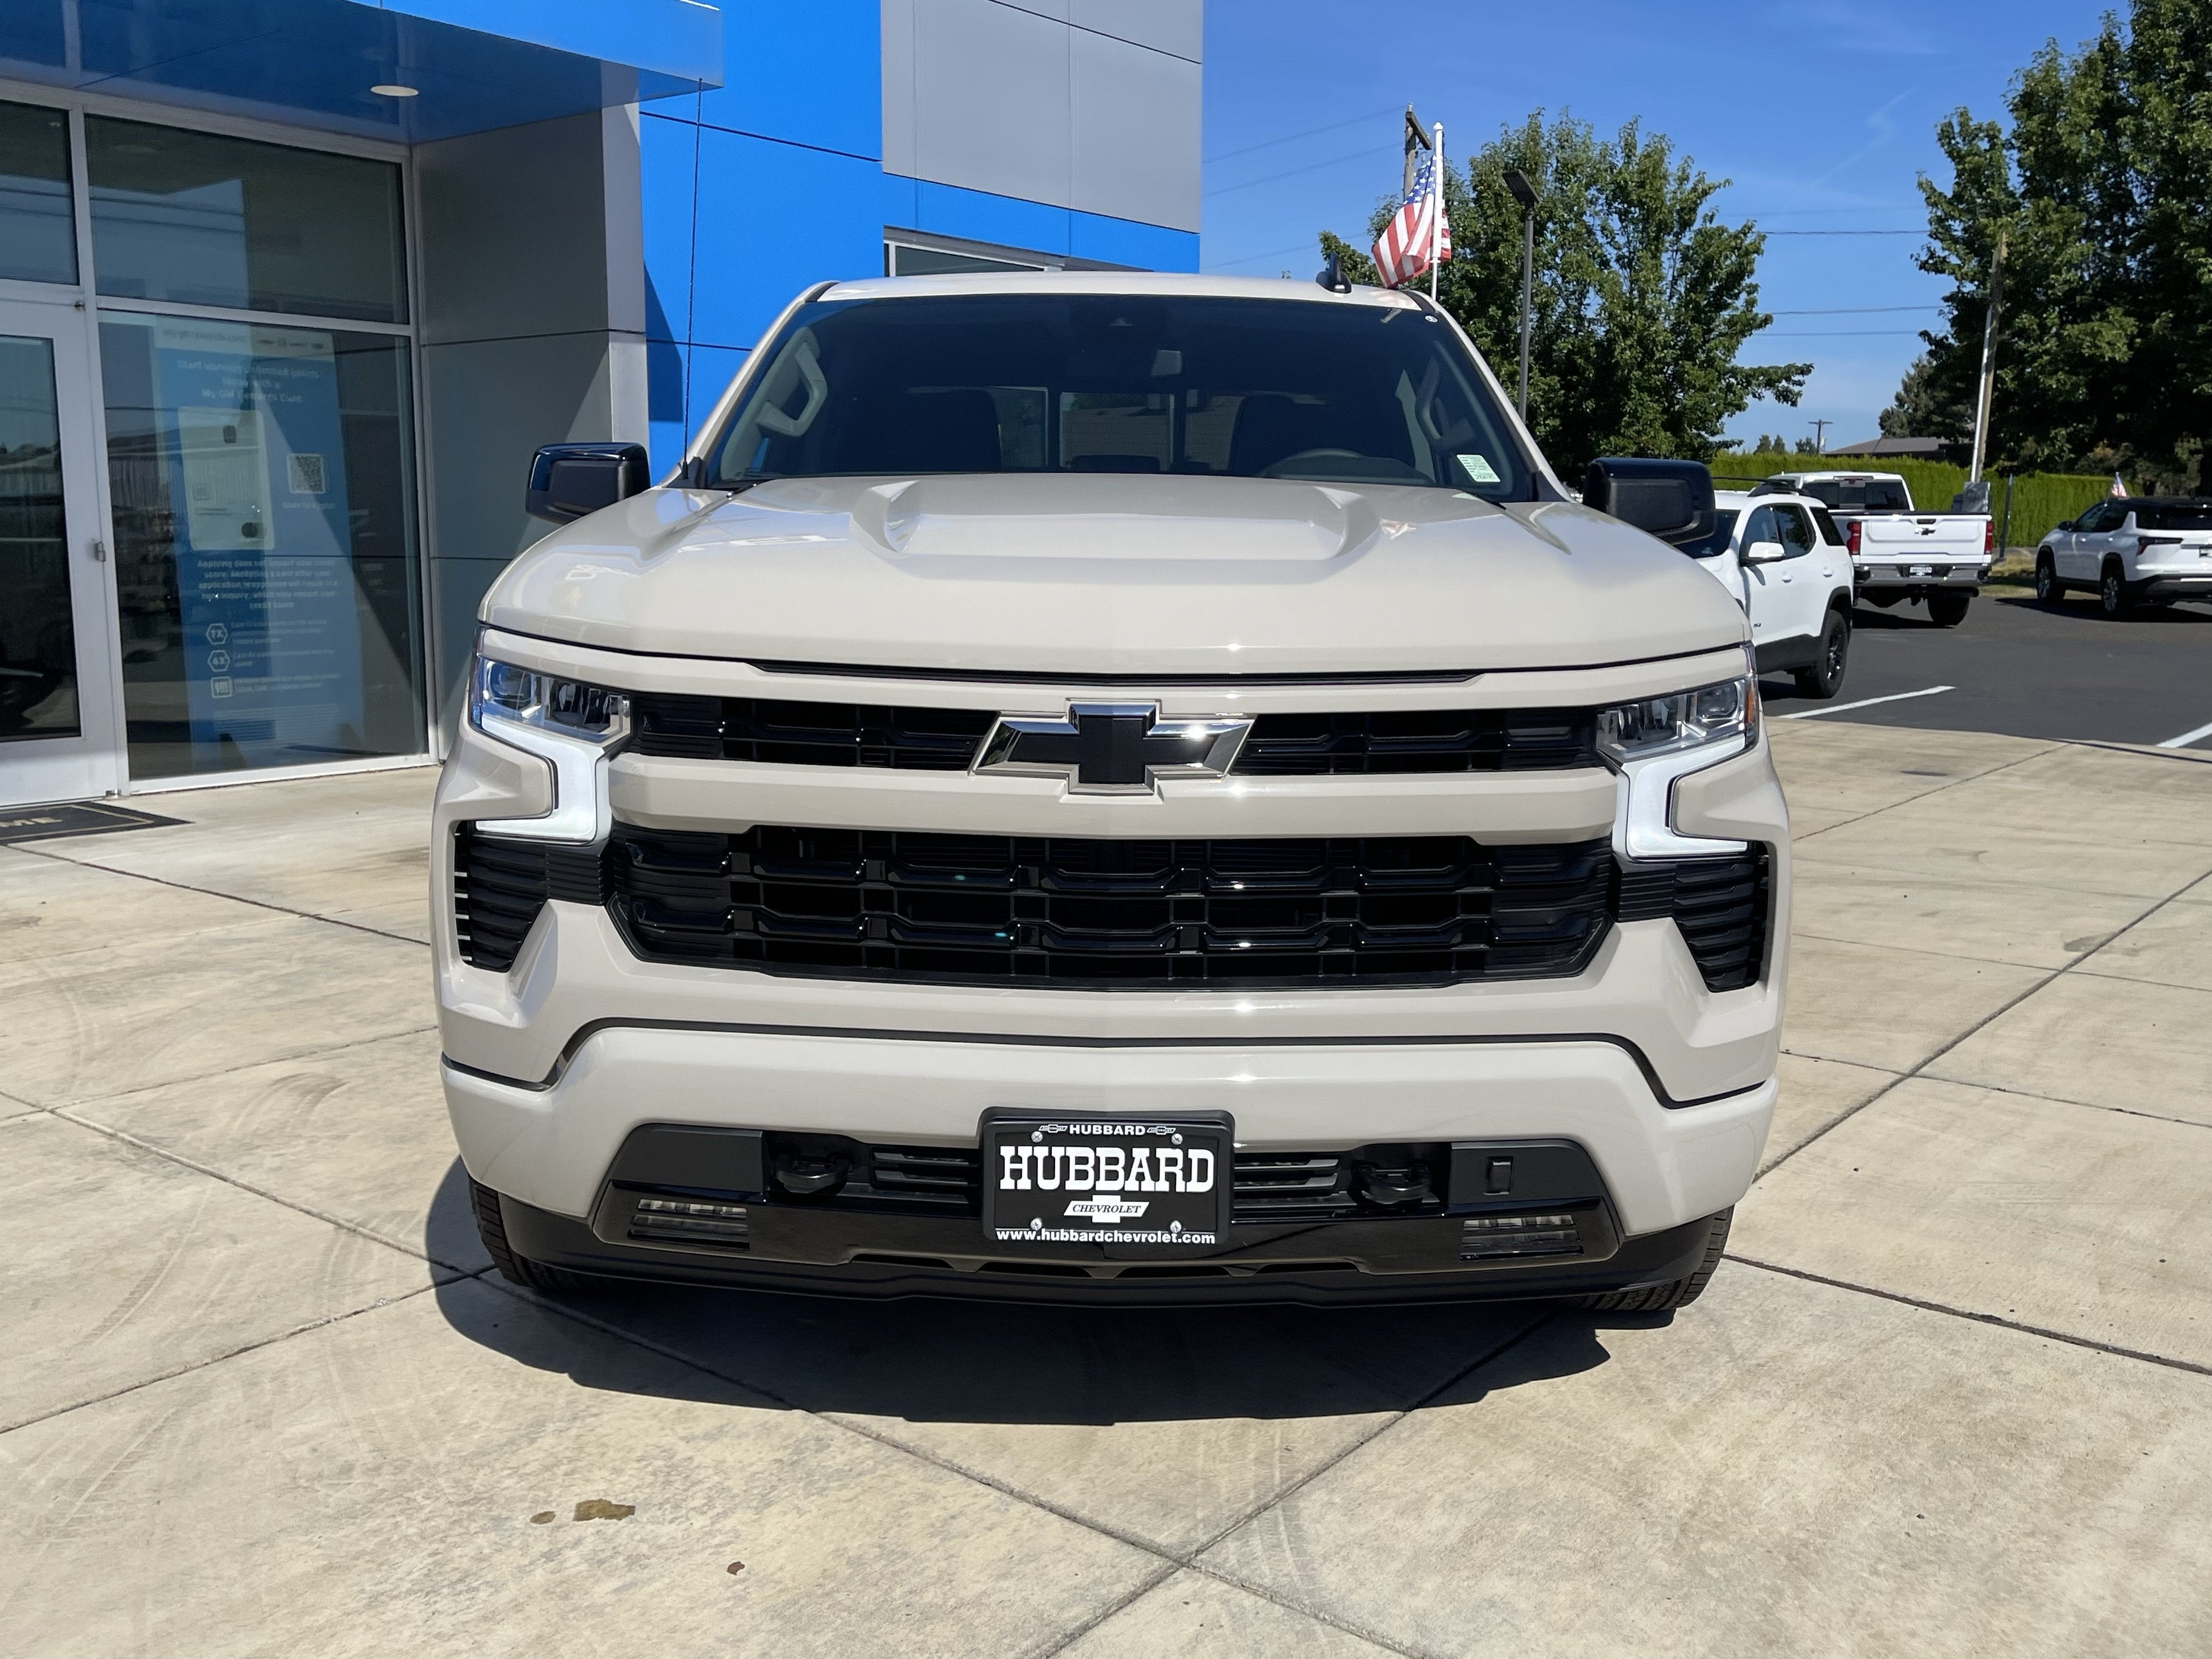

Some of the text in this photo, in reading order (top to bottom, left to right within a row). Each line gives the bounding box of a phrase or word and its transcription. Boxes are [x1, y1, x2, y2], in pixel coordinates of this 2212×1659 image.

[1069, 1124, 1146, 1136] HUBBARD
[999, 1145, 1215, 1193] HUBBARD
[1073, 1204, 1142, 1214] CHEVROLET
[996, 1228, 1215, 1244] www.hubbardchevrolet.com
